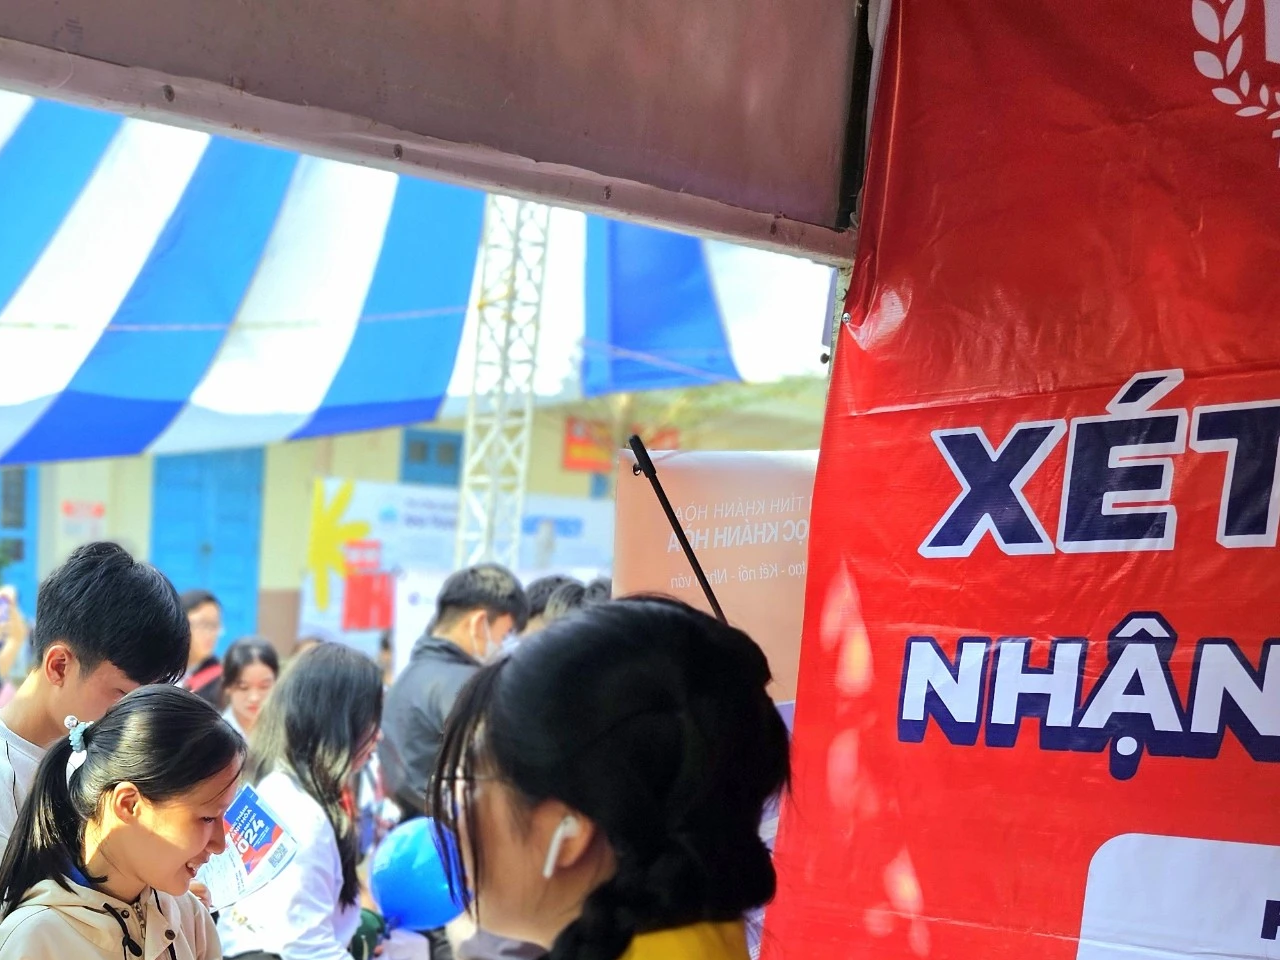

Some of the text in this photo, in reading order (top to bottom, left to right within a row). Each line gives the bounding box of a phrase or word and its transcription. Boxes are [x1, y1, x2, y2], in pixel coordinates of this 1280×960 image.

[918, 369, 1280, 558] XÉT
[898, 612, 1280, 780] NHẬN
[237, 819, 265, 853] 024
